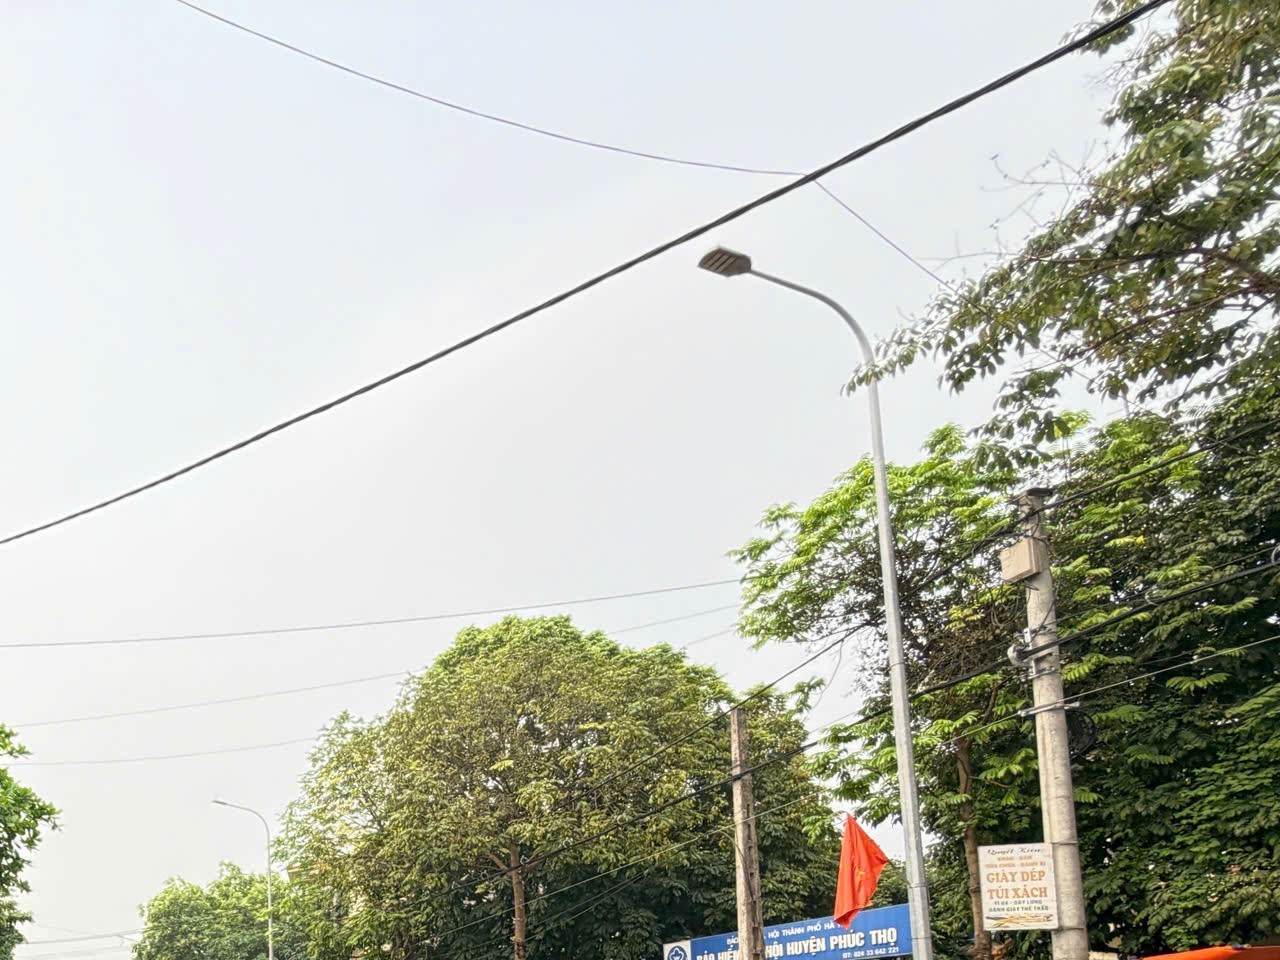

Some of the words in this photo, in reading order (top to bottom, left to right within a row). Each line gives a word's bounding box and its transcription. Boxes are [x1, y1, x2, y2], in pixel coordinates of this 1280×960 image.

[1021, 868, 1046, 882] DÉP
[987, 885, 1009, 900] TÚI
[1012, 884, 1048, 899] XÁCH
[782, 926, 805, 936] THÀNH
[806, 921, 821, 932] PHỐ
[824, 920, 835, 930] HÀ
[765, 941, 784, 960] HỘI
[786, 935, 826, 956] HUYỆN
[829, 929, 865, 950] PHÚC
[869, 927, 897, 946] THỌ
